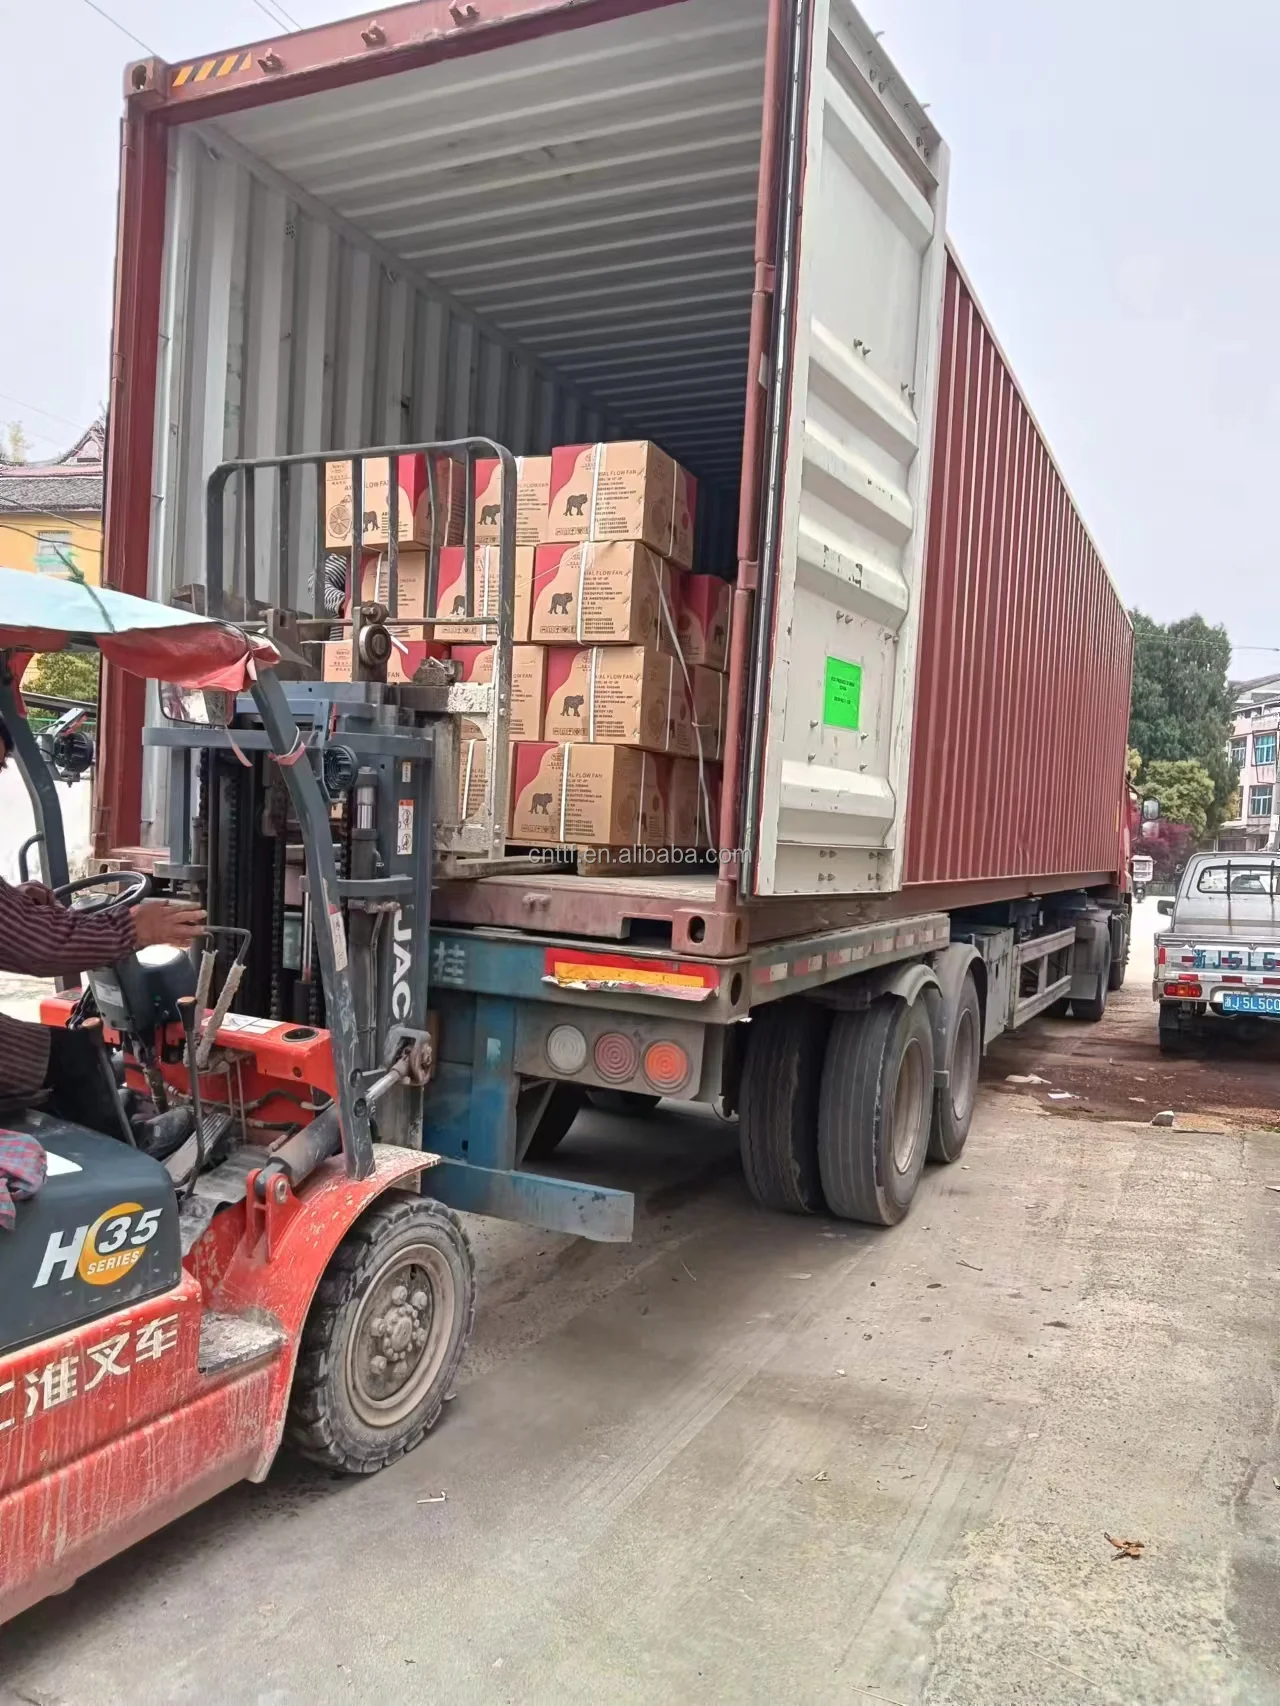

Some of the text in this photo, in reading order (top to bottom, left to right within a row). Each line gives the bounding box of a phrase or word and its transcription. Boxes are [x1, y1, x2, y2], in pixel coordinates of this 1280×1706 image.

[392, 909, 412, 1020] JAC
[87, 1250, 141, 1275] SERIES
[98, 1208, 163, 1253] 35
[0, 1314, 179, 1431] 淮叉车
